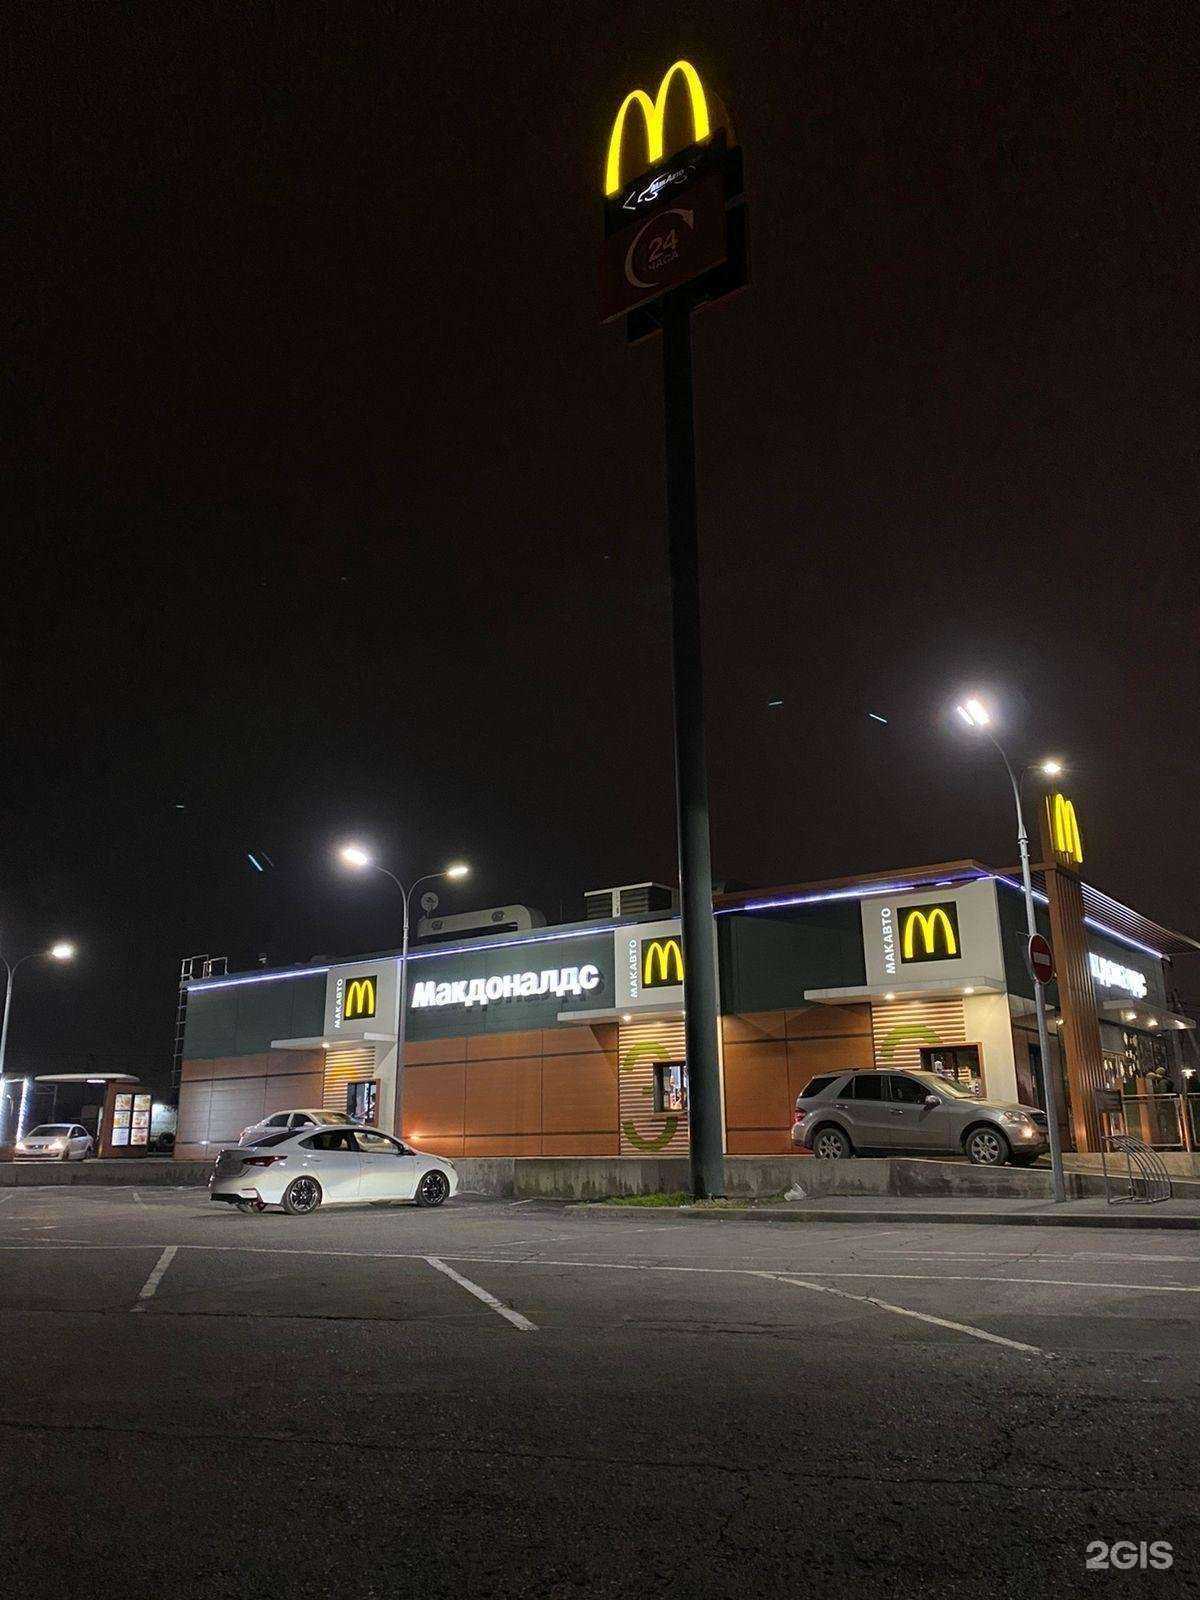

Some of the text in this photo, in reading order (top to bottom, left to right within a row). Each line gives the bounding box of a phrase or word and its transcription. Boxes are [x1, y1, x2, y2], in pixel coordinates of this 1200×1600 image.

[881, 907, 896, 974] МАКАВТО
[411, 964, 598, 1008] Макдоналдс
[629, 939, 638, 998] МАКАВТО
[334, 978, 343, 1028] МАКАВТО
